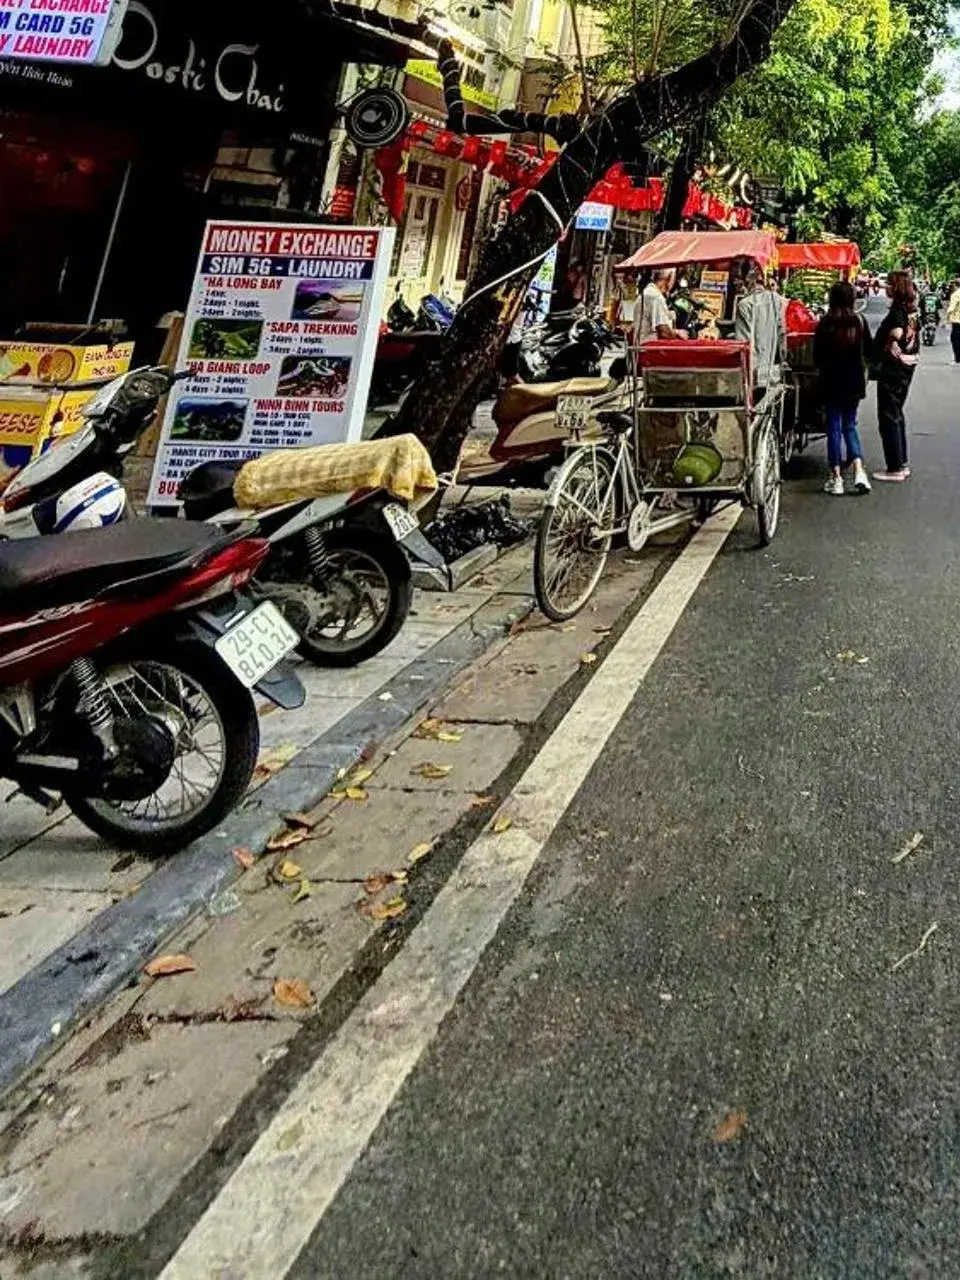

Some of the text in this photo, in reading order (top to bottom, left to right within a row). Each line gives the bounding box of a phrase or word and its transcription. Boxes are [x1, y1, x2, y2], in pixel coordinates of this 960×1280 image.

[15, 13, 65, 33] CARD
[70, 17, 94, 35] 5G
[13, 35, 93, 58] LAUNDRY
[215, 43, 284, 112] Chai
[210, 229, 375, 257] MONEY EXCHANGE
[209, 256, 244, 274] SIM
[247, 258, 271, 275] 5G
[288, 260, 366, 278] LAUNDRY
[226, 277, 257, 289] LONG
[260, 278, 283, 290] BAY
[303, 324, 358, 335] TREKKING
[312, 401, 344, 412] TOURS
[227, 610, 275, 656] 29-C1
[238, 623, 294, 679] 840.34
